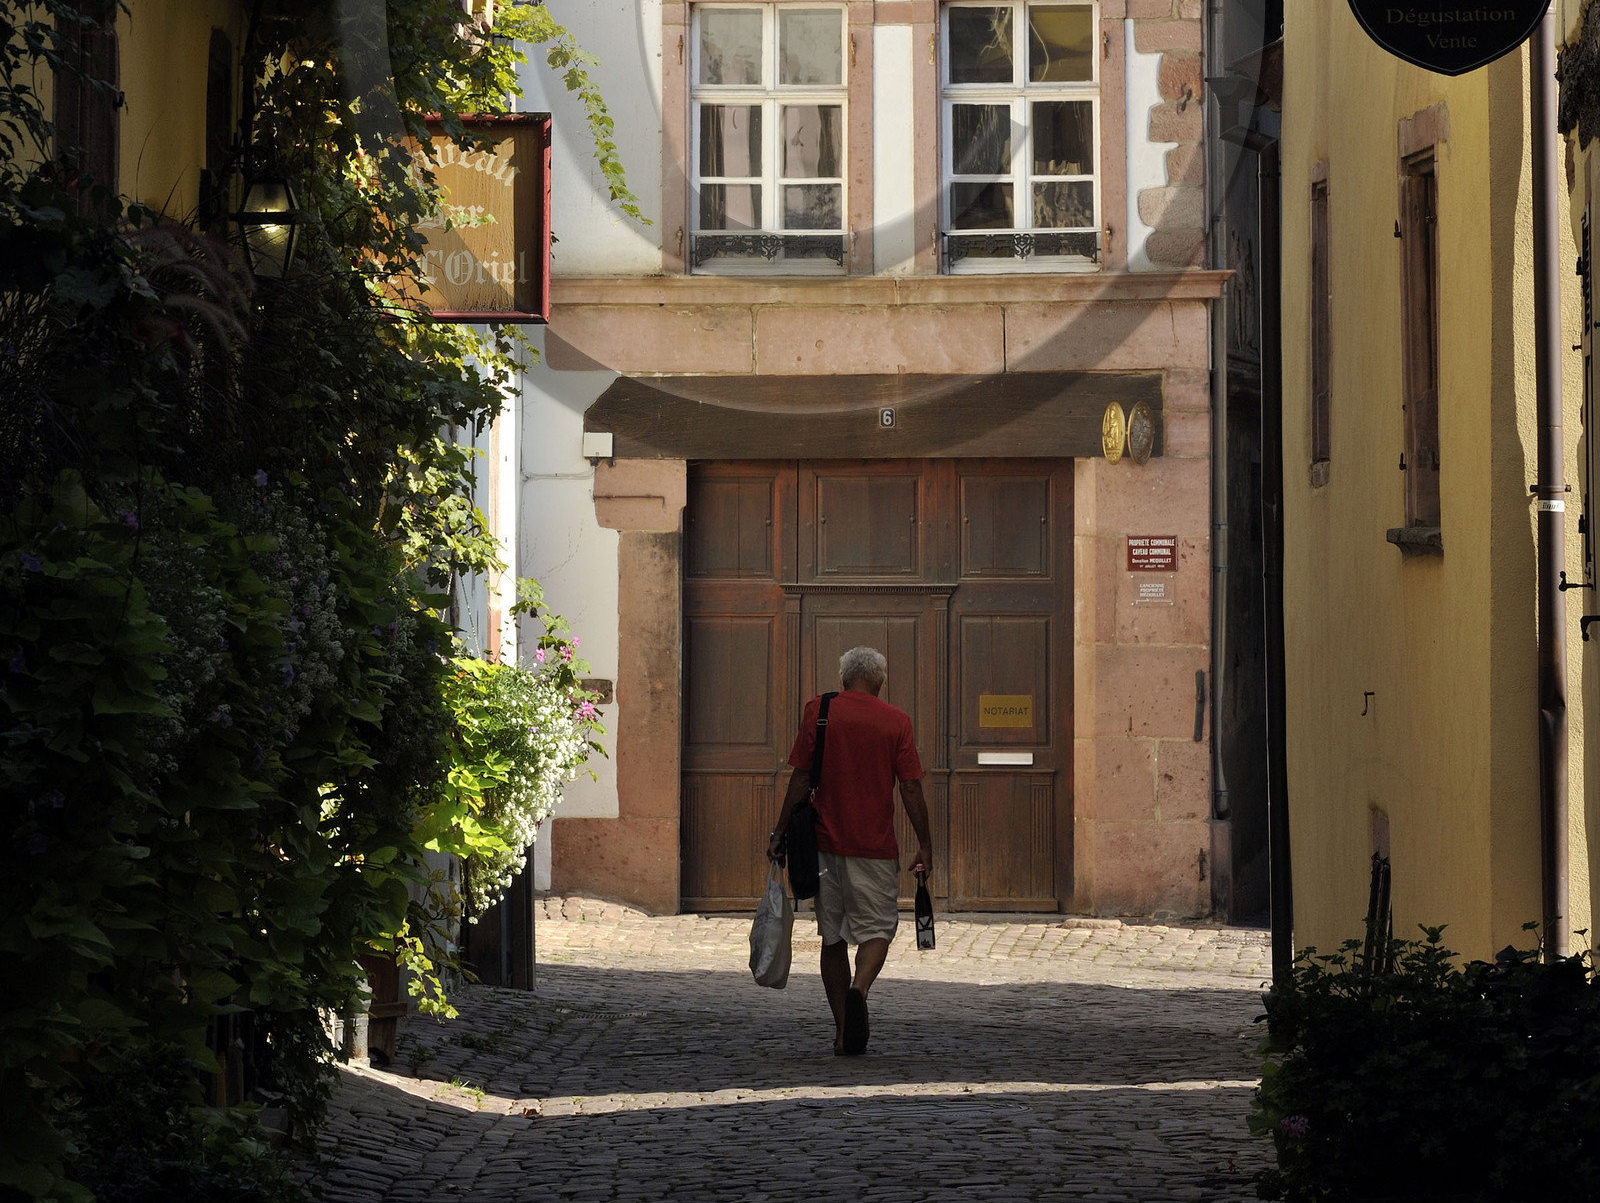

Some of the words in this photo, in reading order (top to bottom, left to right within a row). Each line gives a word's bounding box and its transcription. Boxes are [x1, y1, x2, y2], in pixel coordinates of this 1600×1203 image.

[1386, 6, 1516, 27] Dégustation
[1426, 33, 1477, 49] Vente
[409, 142, 521, 186] aveau
[882, 410, 893, 425] 6
[984, 707, 1029, 716] NOTARIAT
